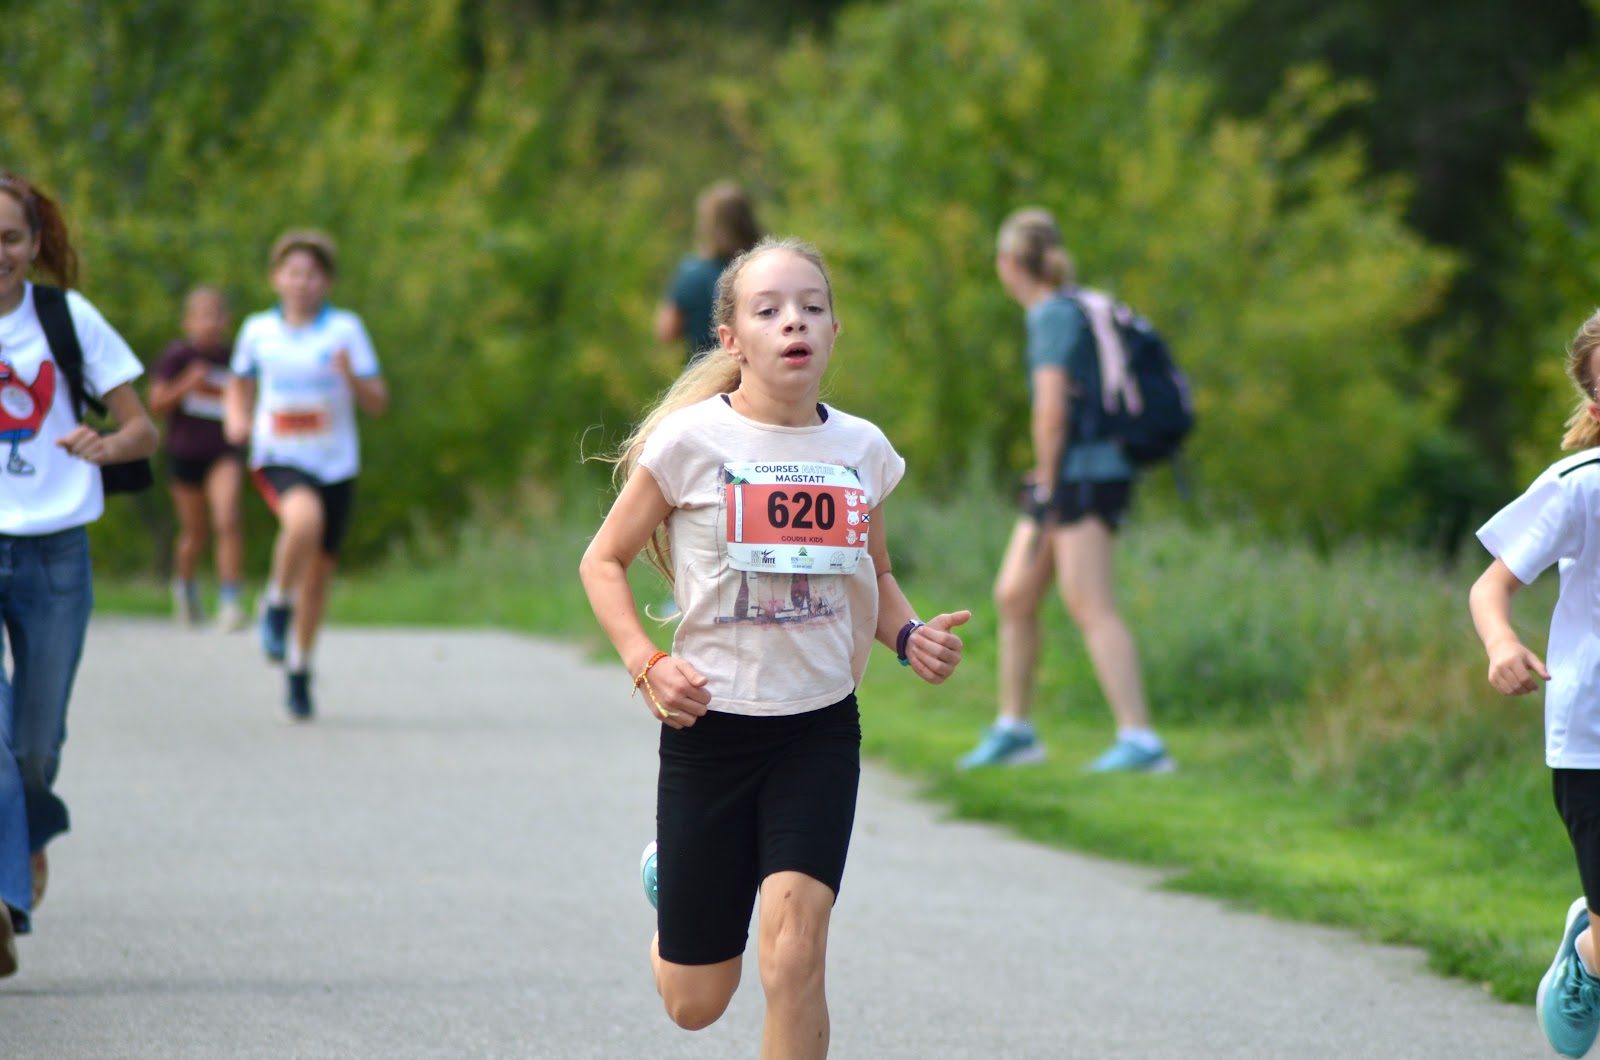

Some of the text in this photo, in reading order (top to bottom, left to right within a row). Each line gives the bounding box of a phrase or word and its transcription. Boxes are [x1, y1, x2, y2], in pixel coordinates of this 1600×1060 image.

[755, 465, 799, 473] COURSES
[775, 475, 825, 483] MAGSTATT
[767, 491, 835, 530] 620
[781, 535, 807, 543] COURSE
